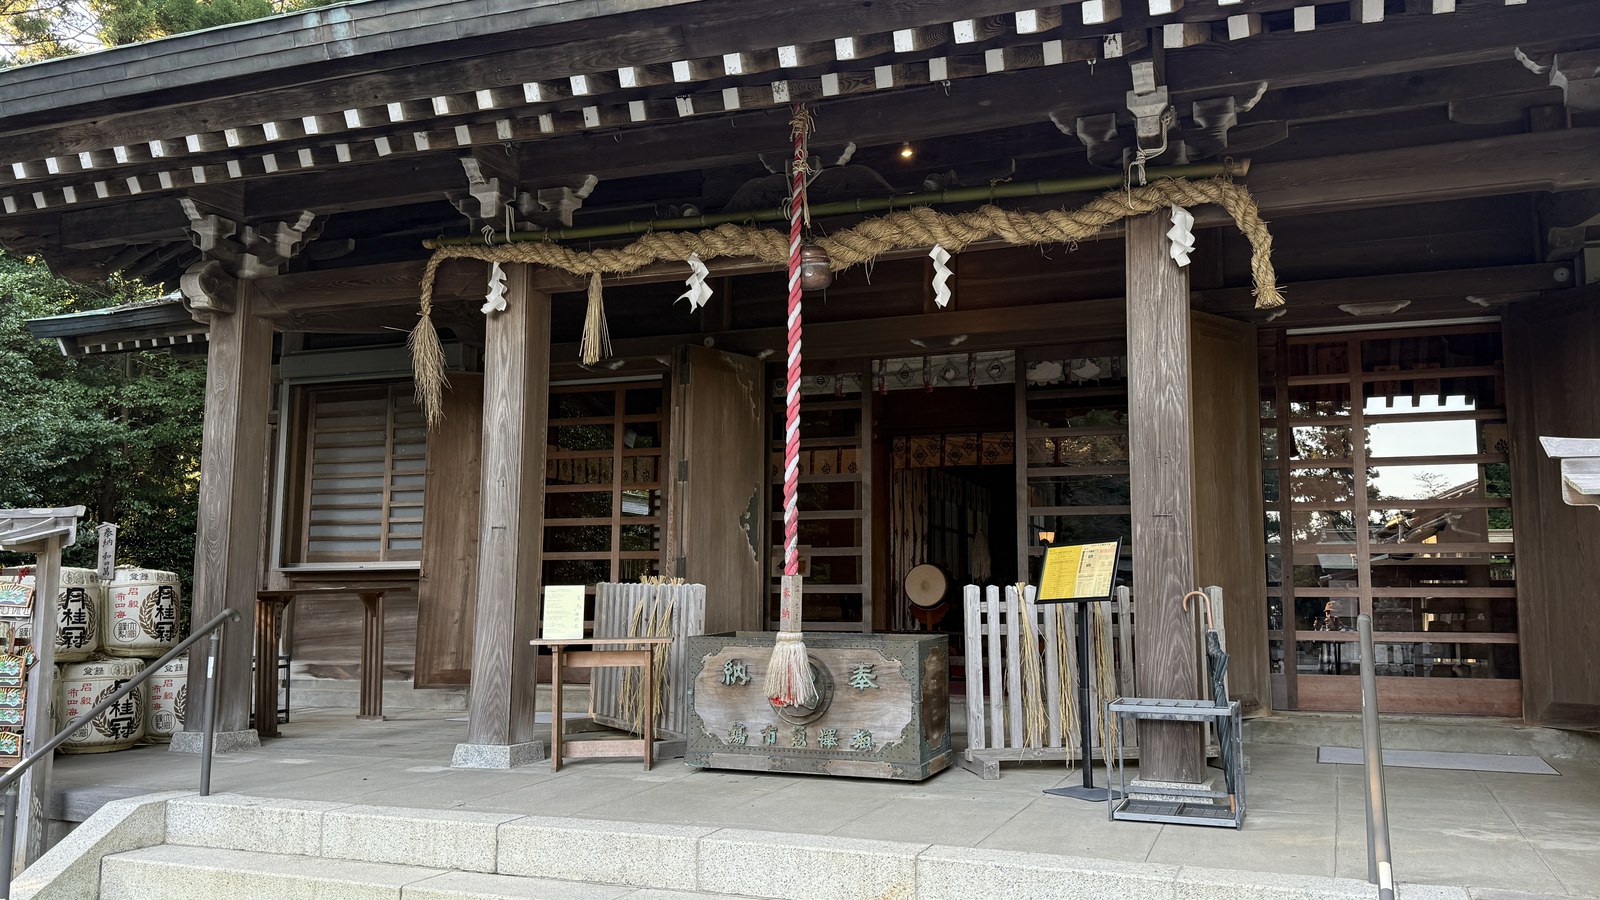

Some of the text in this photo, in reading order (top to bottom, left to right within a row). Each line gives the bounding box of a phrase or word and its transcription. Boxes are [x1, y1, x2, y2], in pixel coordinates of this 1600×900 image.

[102, 527, 114, 547] 奉納
[61, 587, 87, 649] 月桂冠
[154, 585, 175, 643] 月桂冠
[721, 659, 879, 690] 奉 納
